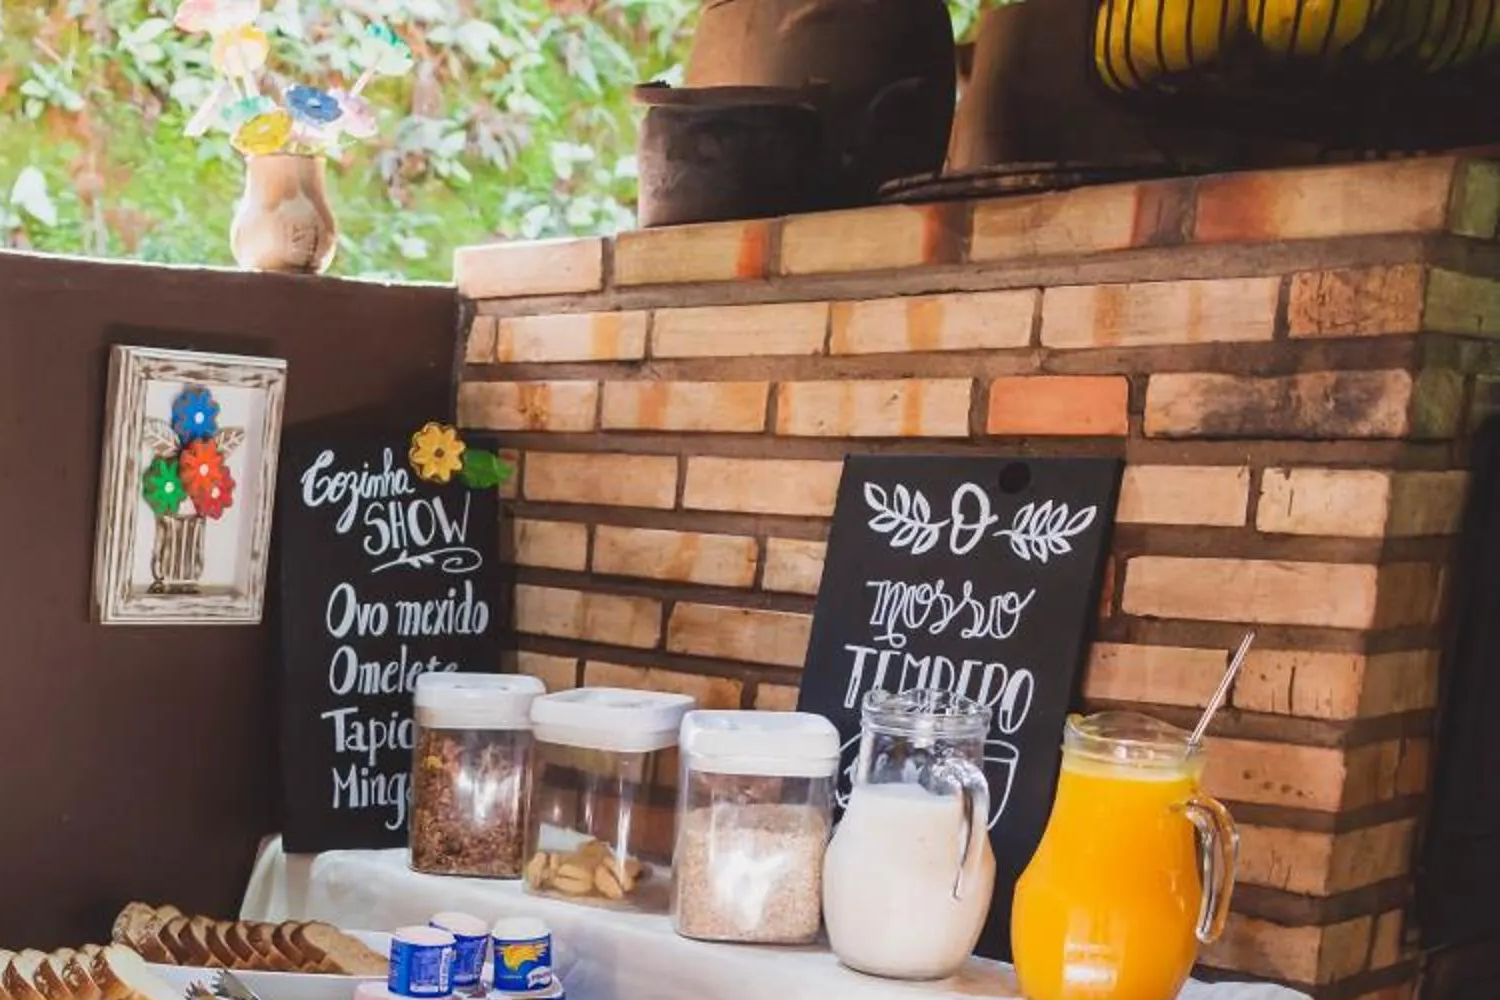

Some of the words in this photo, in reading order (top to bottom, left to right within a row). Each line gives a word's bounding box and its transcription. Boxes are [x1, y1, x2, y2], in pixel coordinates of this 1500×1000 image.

[302, 447, 415, 534] Cozinha
[363, 490, 471, 555] SHOW
[326, 582, 388, 639] Ovo
[396, 580, 489, 636] mexido
[321, 706, 415, 767] Tapio
[332, 763, 412, 830] Ming
